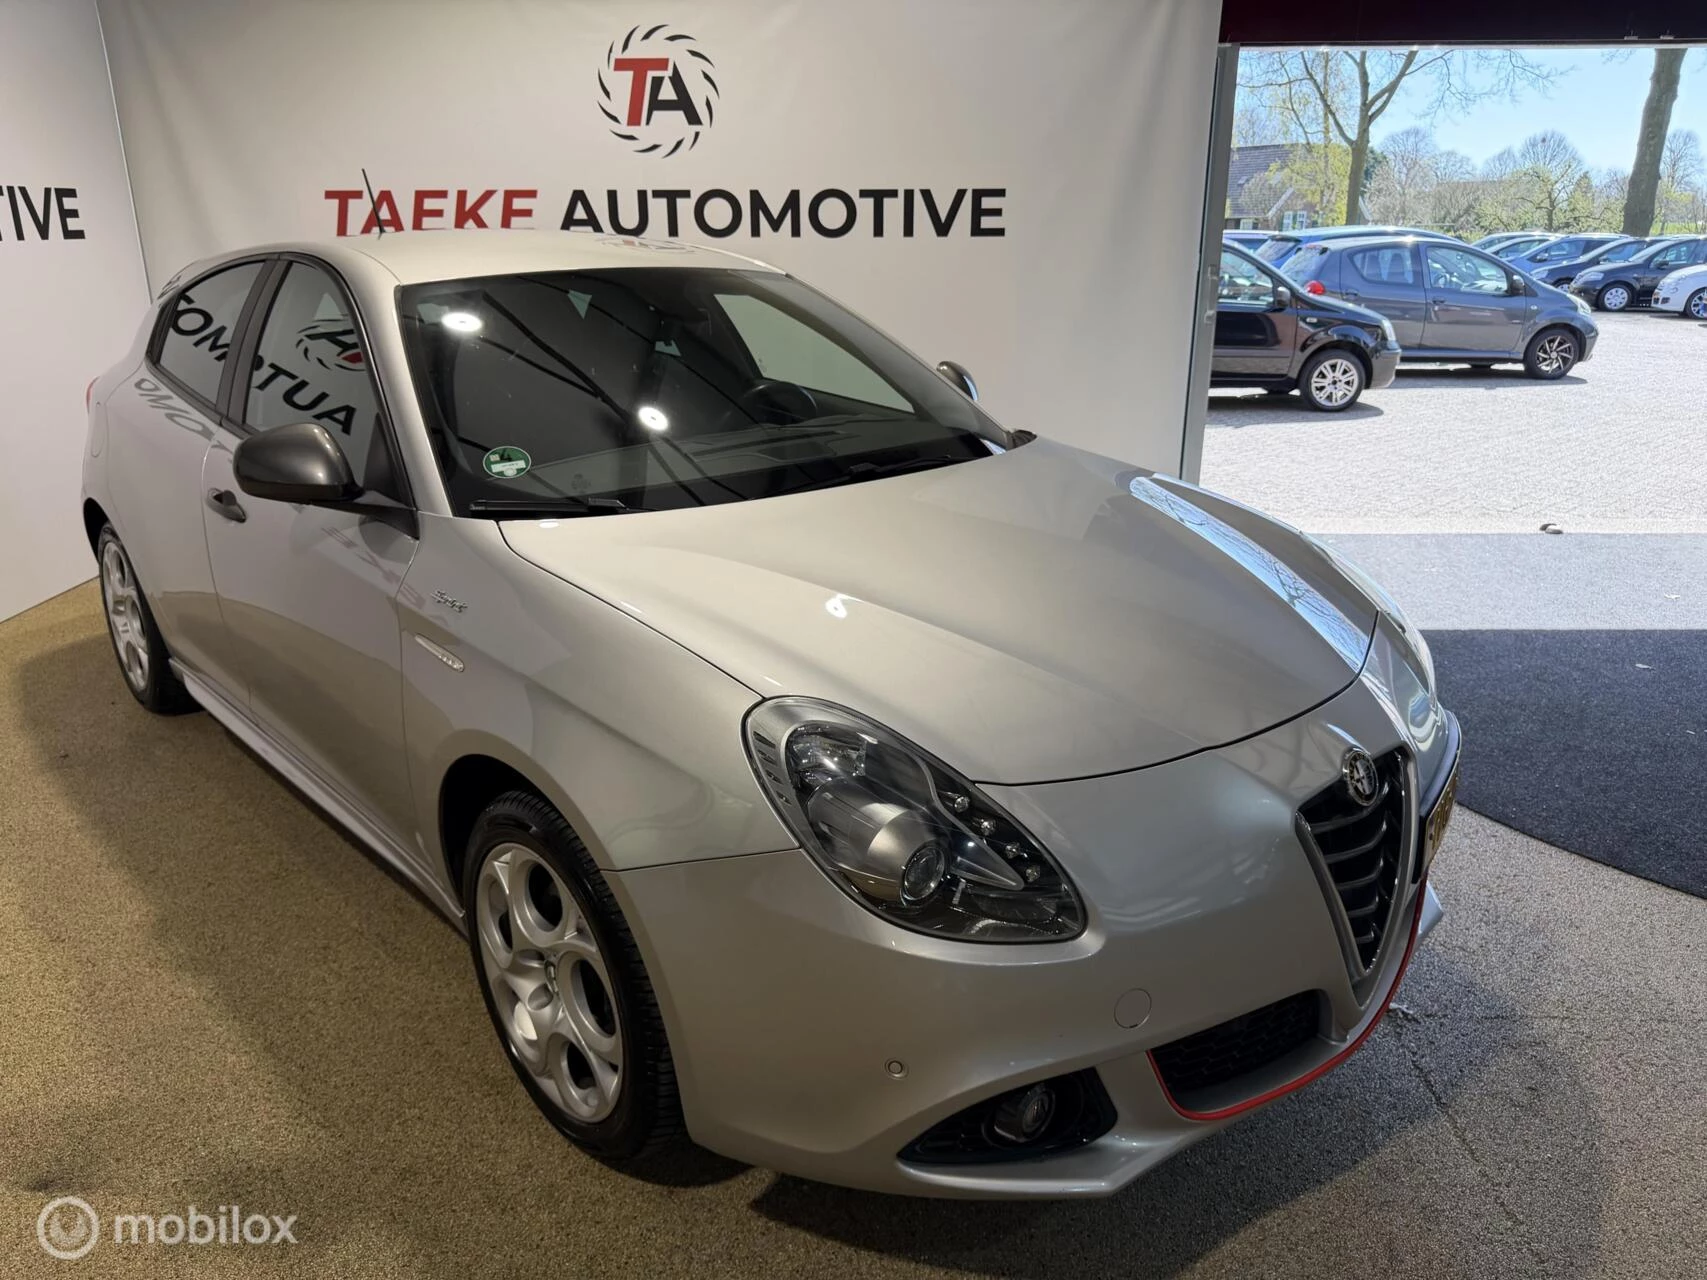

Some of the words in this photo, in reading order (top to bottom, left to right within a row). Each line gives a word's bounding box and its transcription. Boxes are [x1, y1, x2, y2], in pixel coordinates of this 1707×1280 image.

[613, 57, 703, 127] TA
[0, 185, 86, 241] IVE
[324, 189, 538, 237] TAEKE
[560, 188, 1006, 238] AUTOMOTIVE
